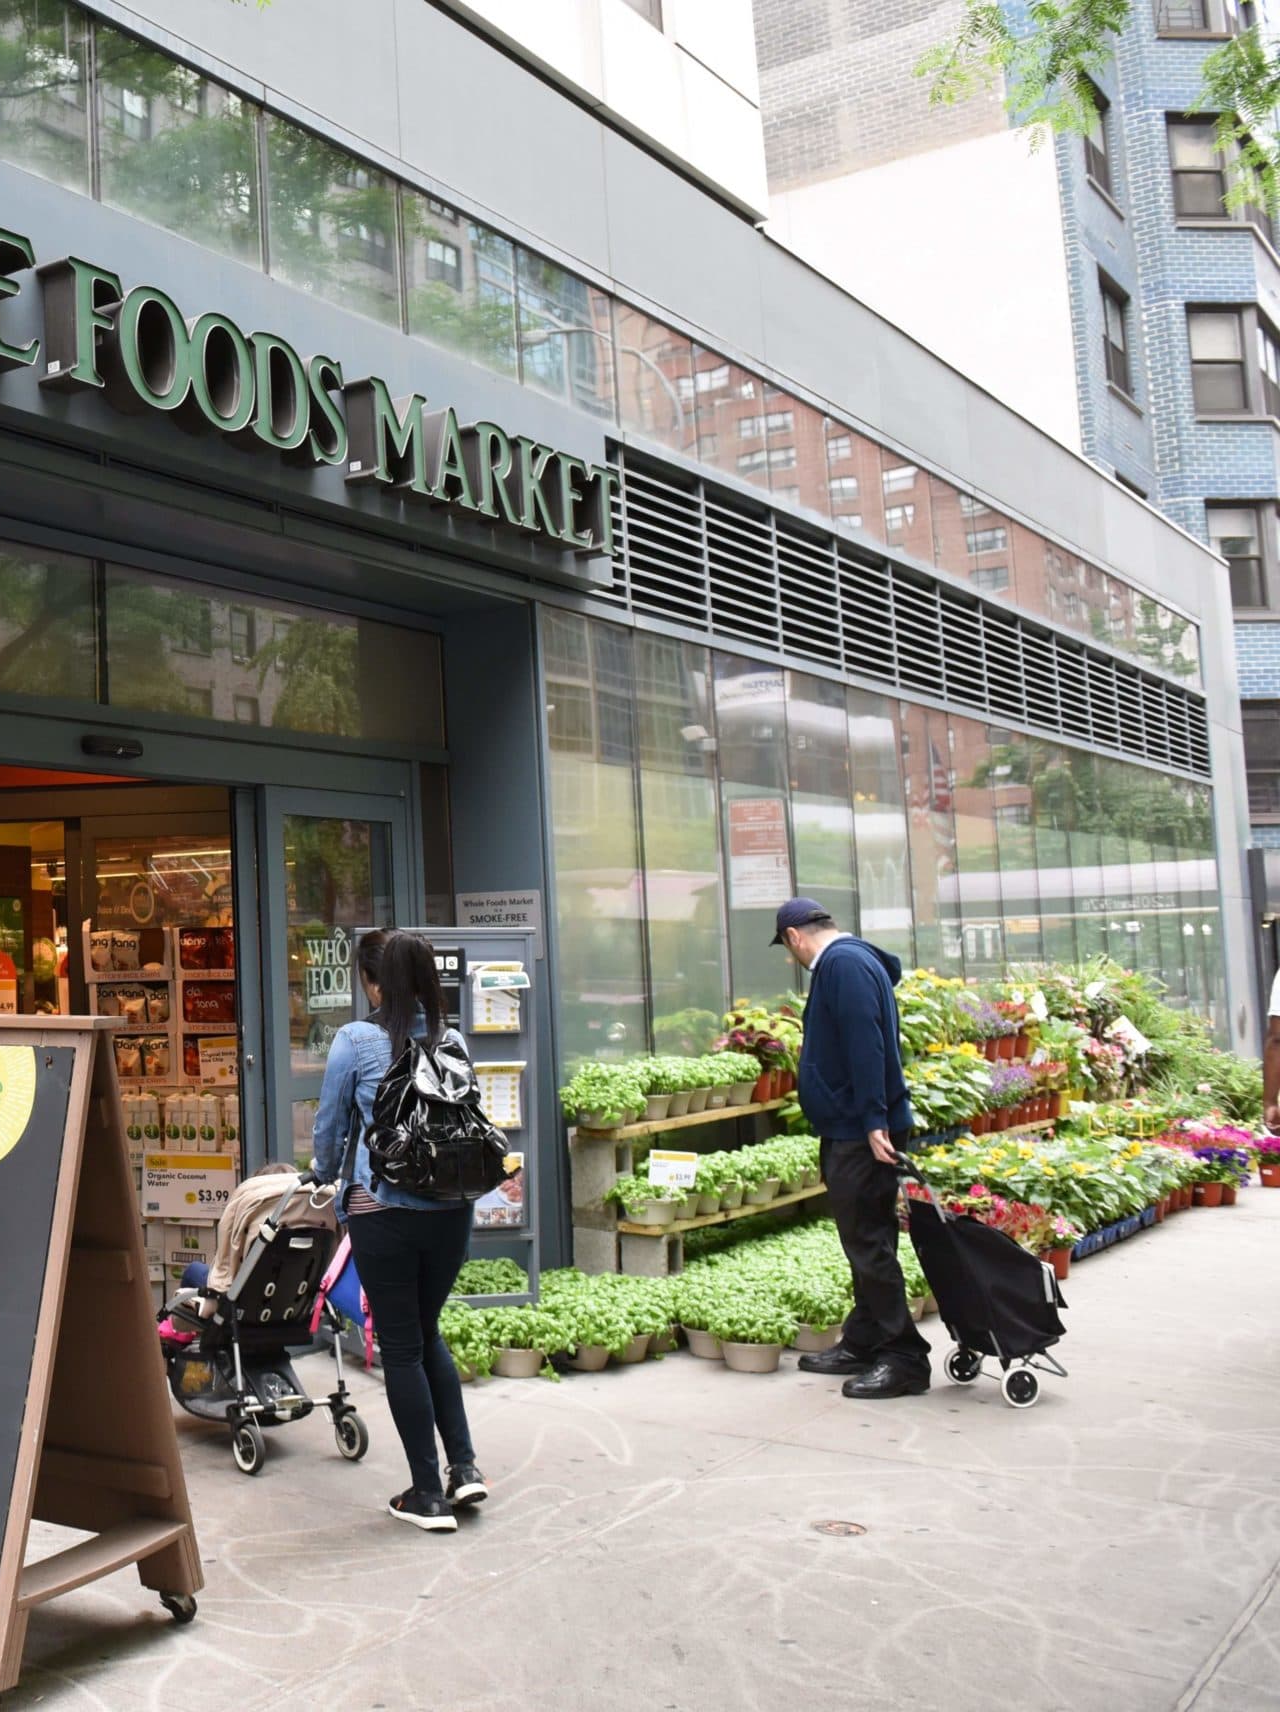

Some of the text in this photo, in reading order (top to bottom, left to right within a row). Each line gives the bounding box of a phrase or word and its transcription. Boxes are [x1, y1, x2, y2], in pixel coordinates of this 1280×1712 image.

[66, 256, 349, 466] FOODS
[370, 377, 622, 557] MARKET
[462, 897, 534, 908] Whole Foods Market
[470, 912, 529, 924] SMOKE-FREE
[90, 937, 109, 949] ang
[306, 936, 352, 966] WHO
[147, 1171, 207, 1182] Organic Coconut
[147, 1180, 170, 1188] Water
[198, 1189, 230, 1203] $3.99
